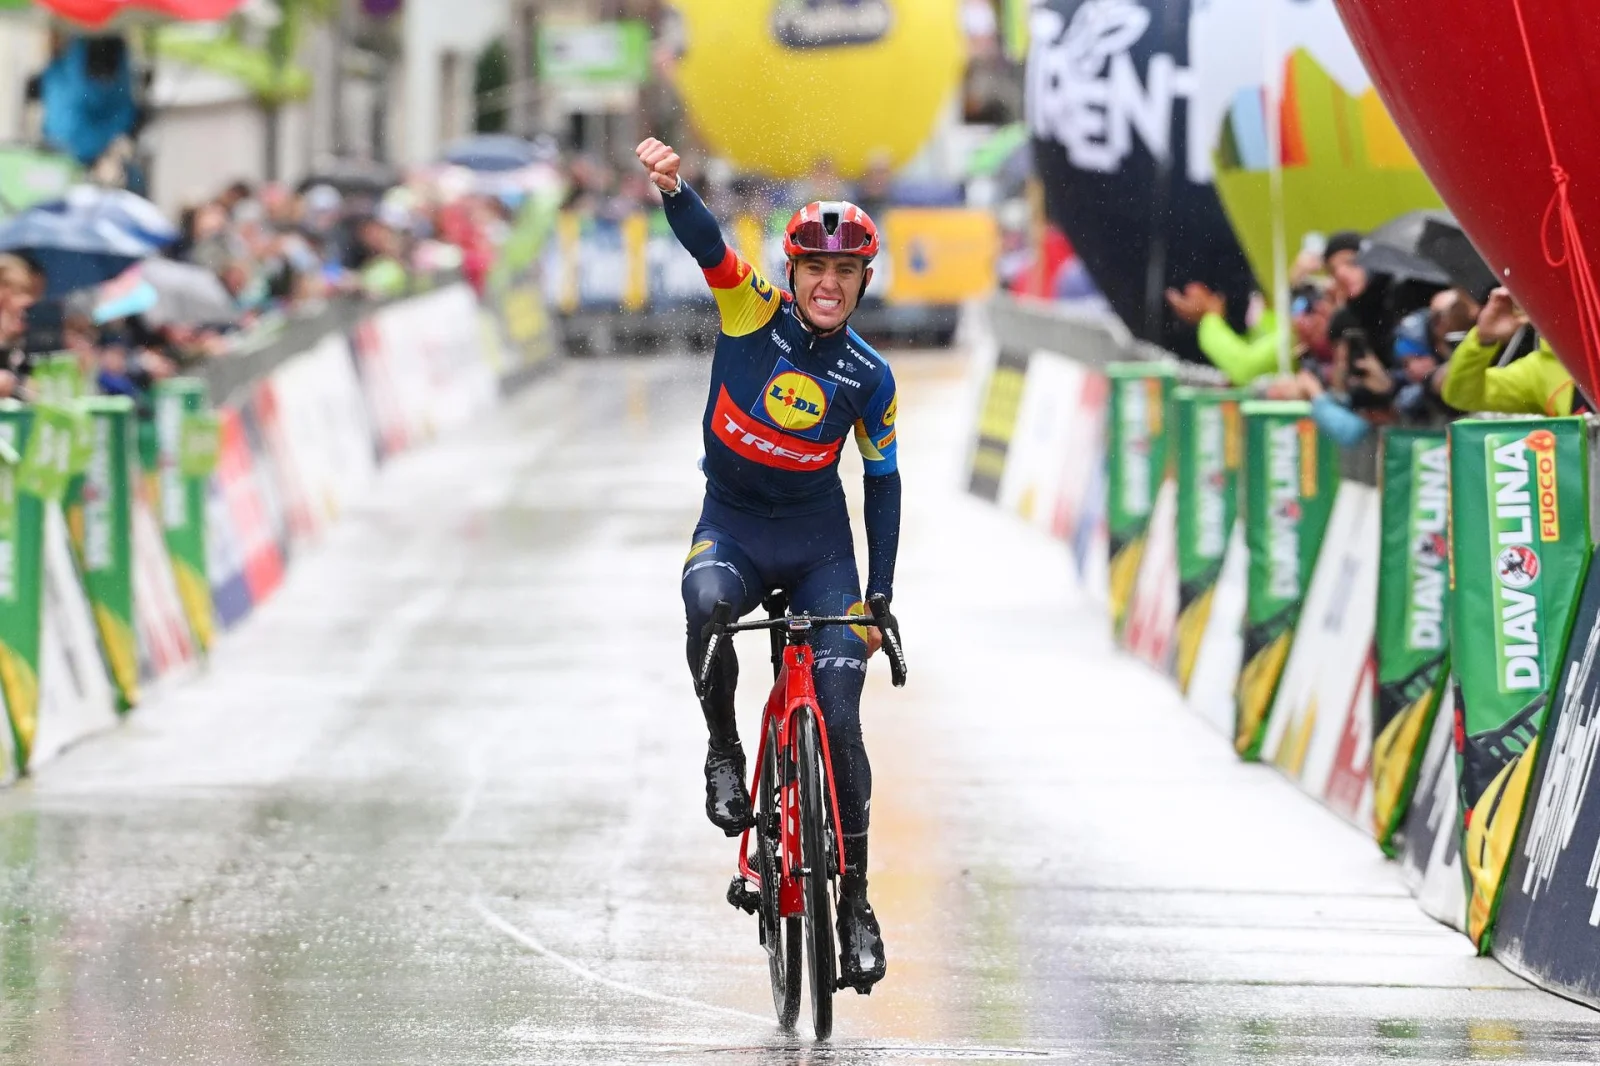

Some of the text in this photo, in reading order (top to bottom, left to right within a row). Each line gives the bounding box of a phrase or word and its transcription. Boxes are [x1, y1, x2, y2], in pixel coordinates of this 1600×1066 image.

[846, 343, 876, 371] TREK
[826, 370, 861, 389] SRAM
[724, 413, 830, 463] TREK
[1540, 457, 1556, 537] FUOCO
[701, 634, 718, 673] SRAM
